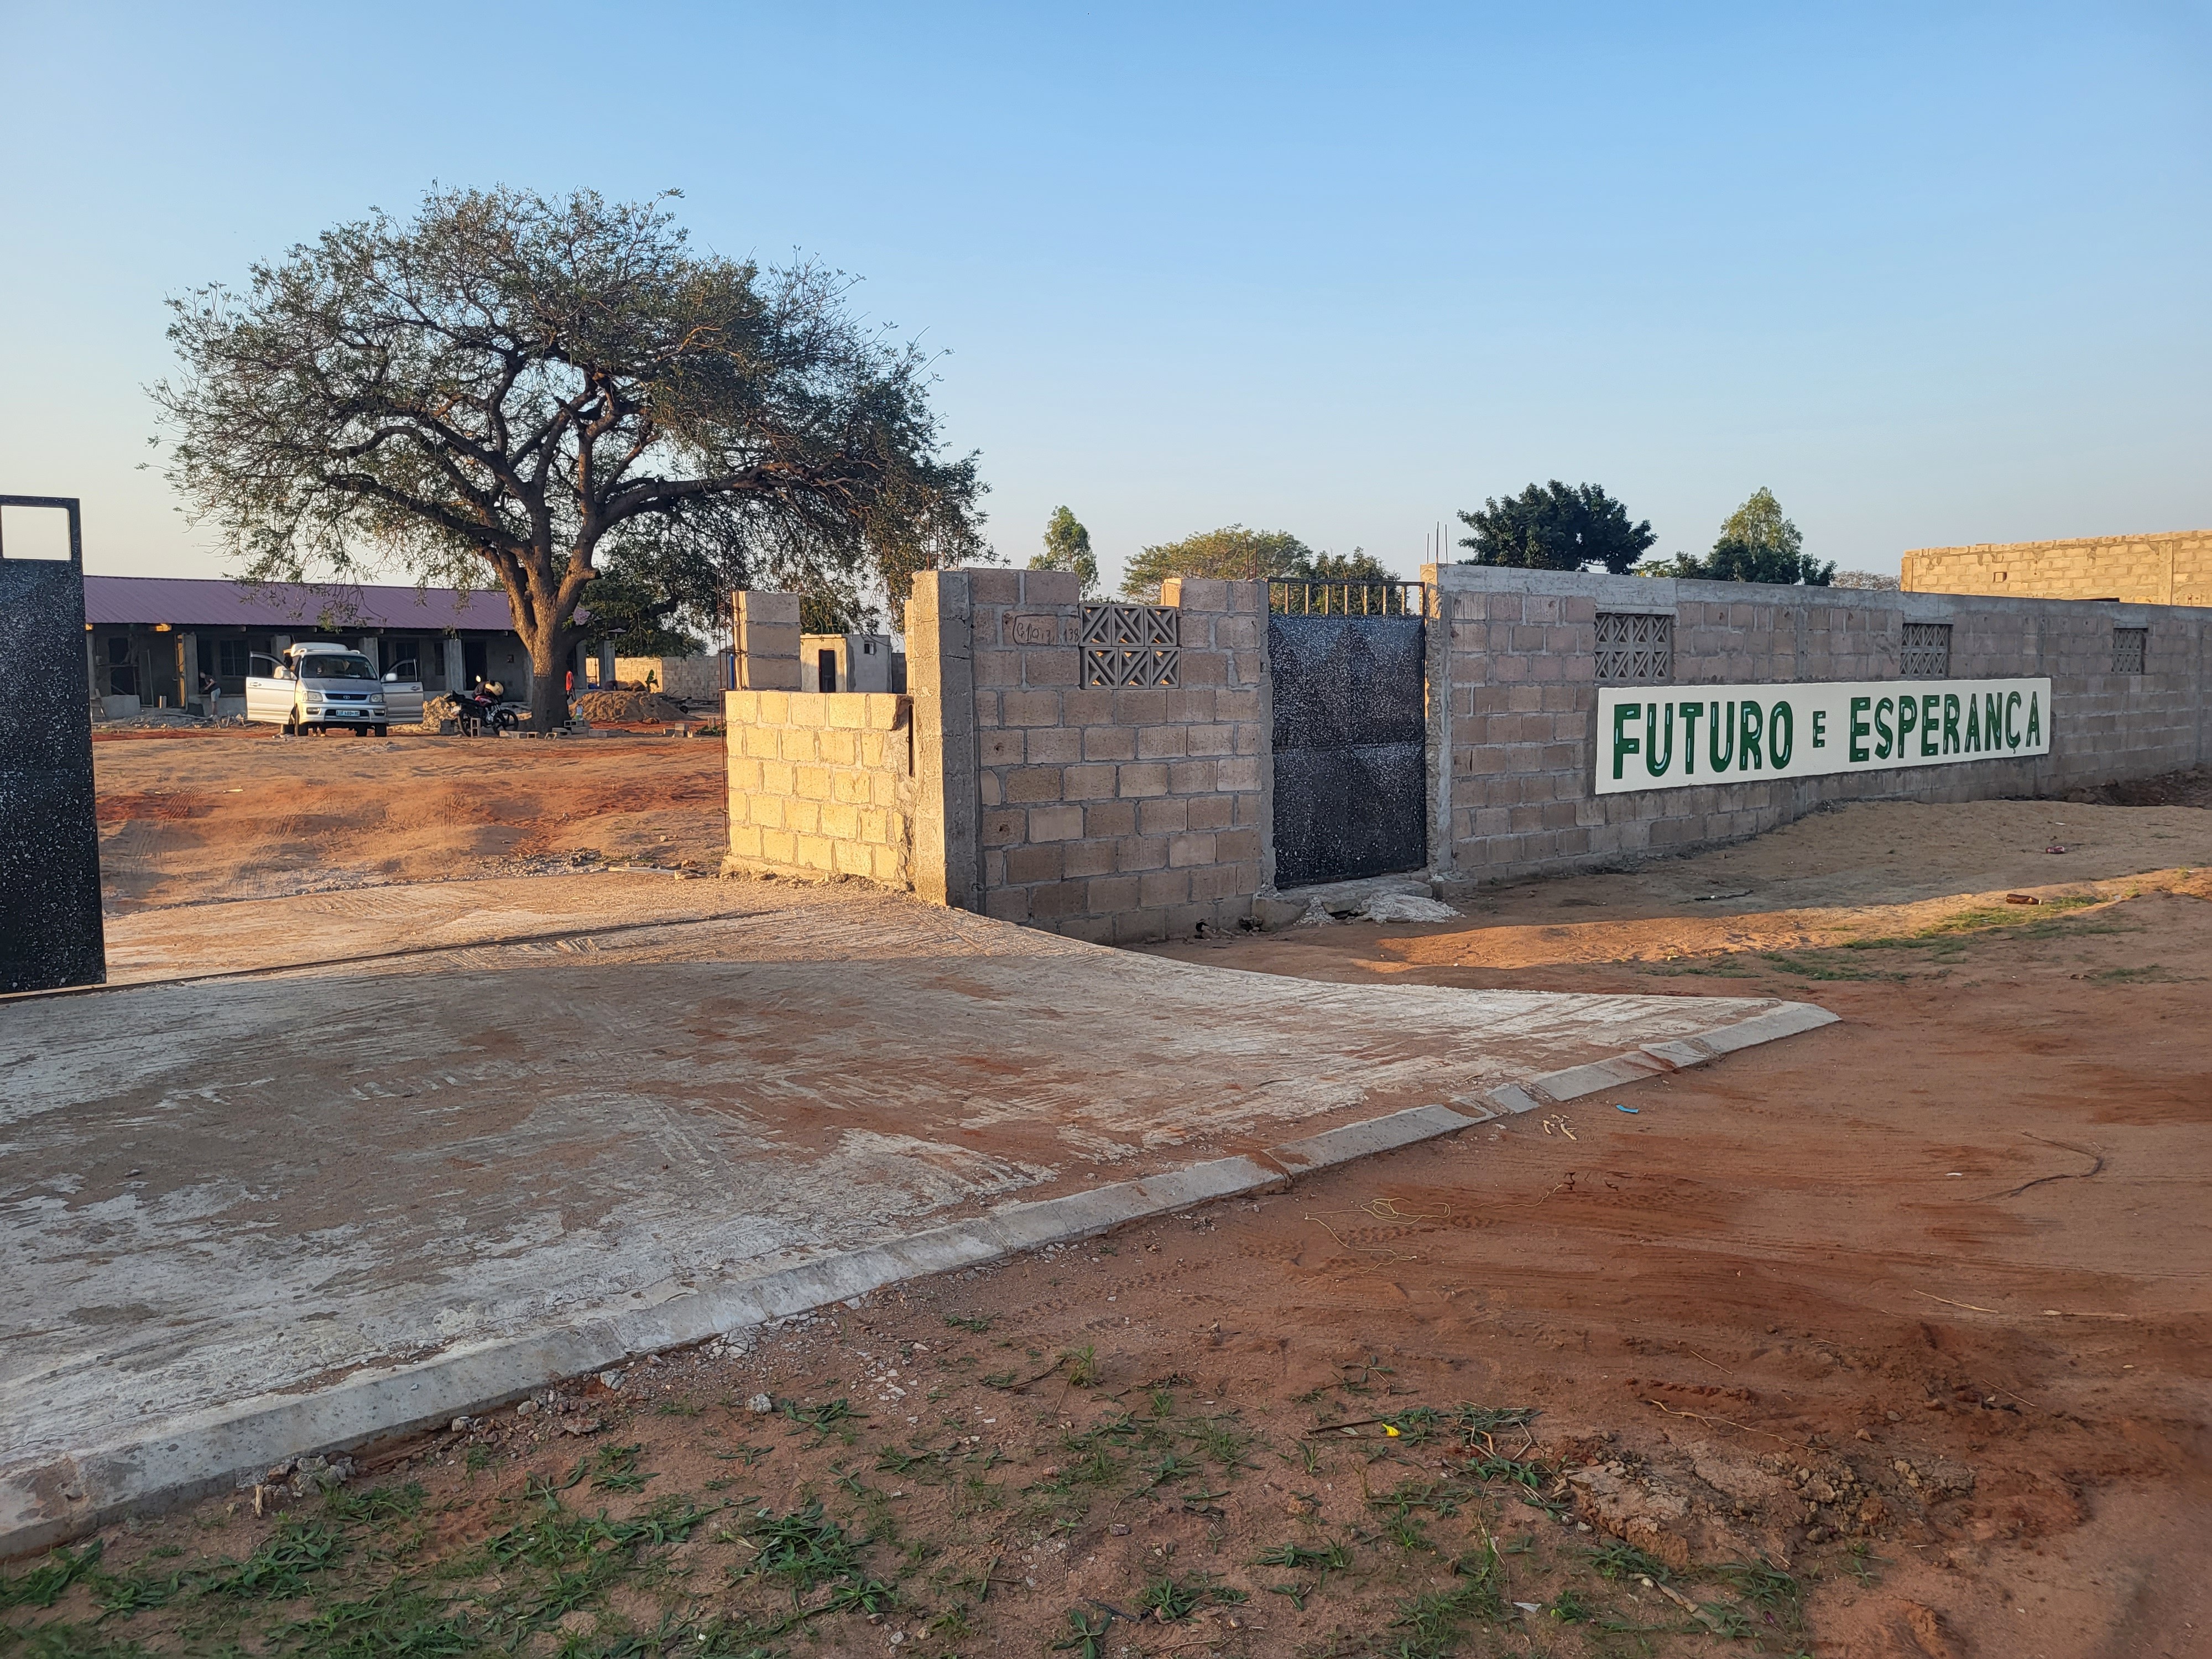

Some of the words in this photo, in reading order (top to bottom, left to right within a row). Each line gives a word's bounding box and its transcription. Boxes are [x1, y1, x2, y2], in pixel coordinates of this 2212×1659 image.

[1613, 700, 1793, 780] FUTURO
[1812, 710, 1827, 748] E
[1849, 691, 2041, 763] ESPERANÇA
